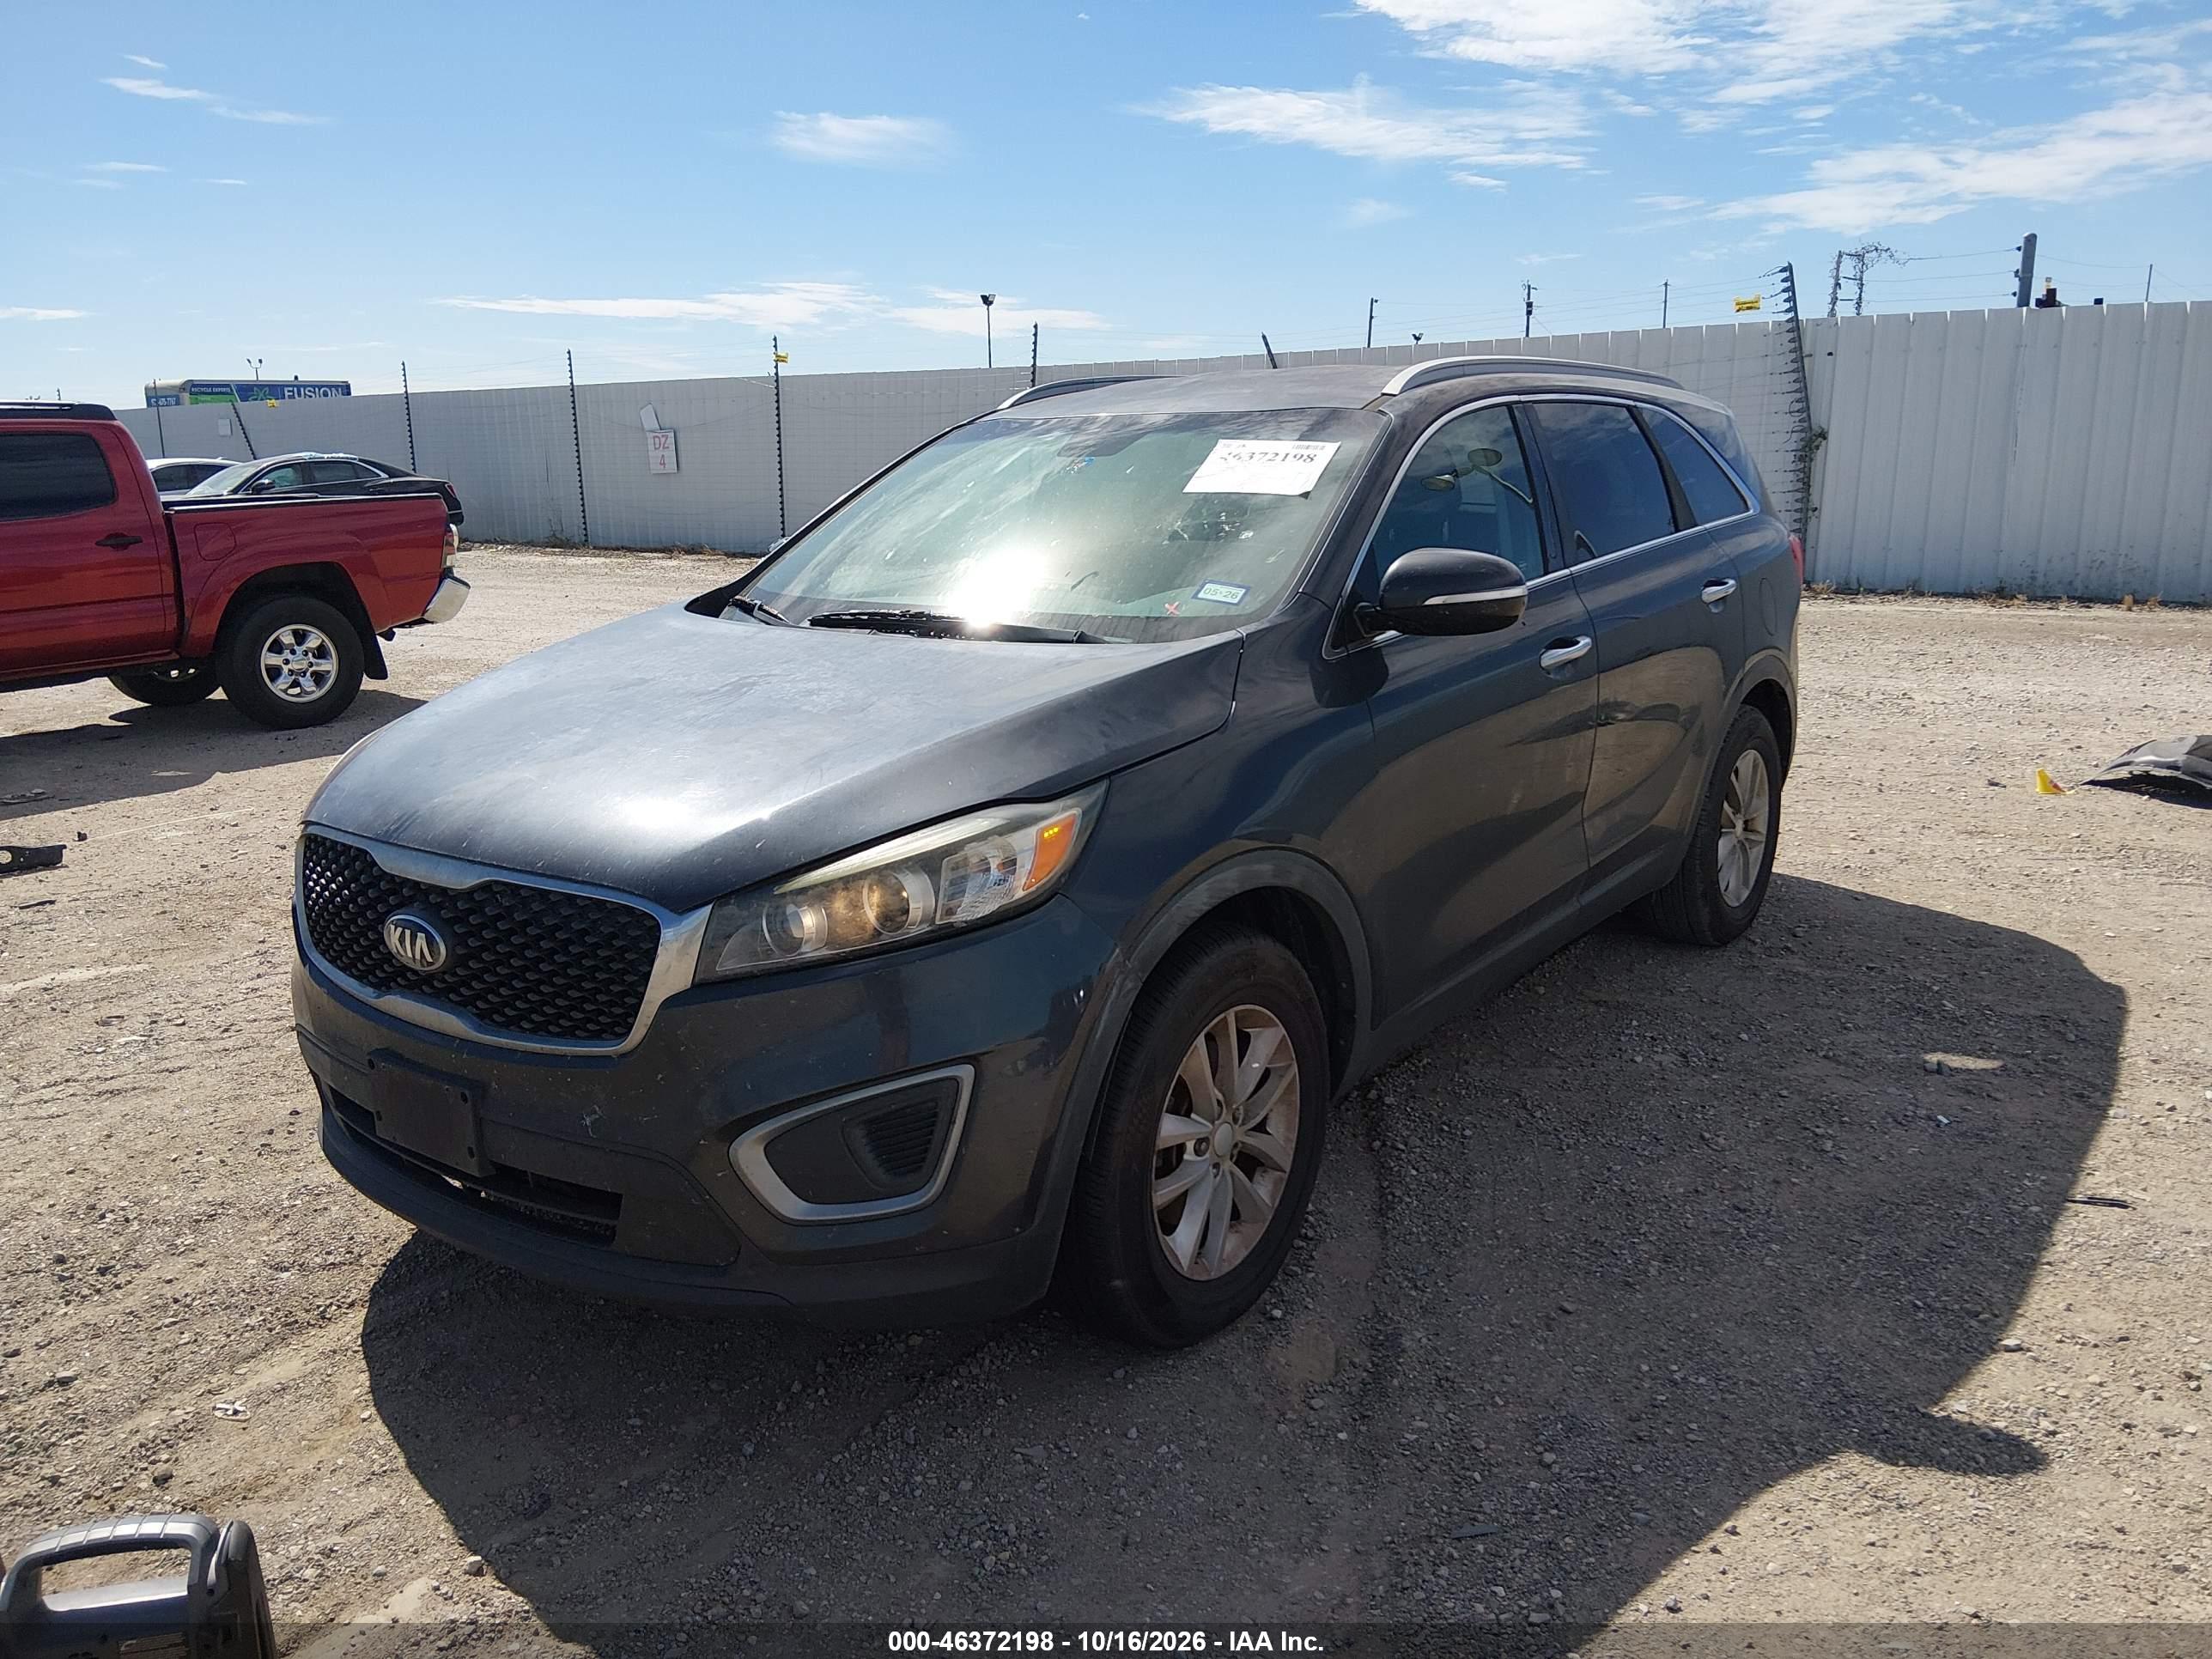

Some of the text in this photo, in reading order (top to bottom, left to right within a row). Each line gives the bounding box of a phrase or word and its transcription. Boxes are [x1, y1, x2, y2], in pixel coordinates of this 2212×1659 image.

[283, 386, 343, 399] FUSION
[652, 434, 670, 451] DZ
[659, 453, 667, 469] 4
[389, 922, 434, 963] KIA
